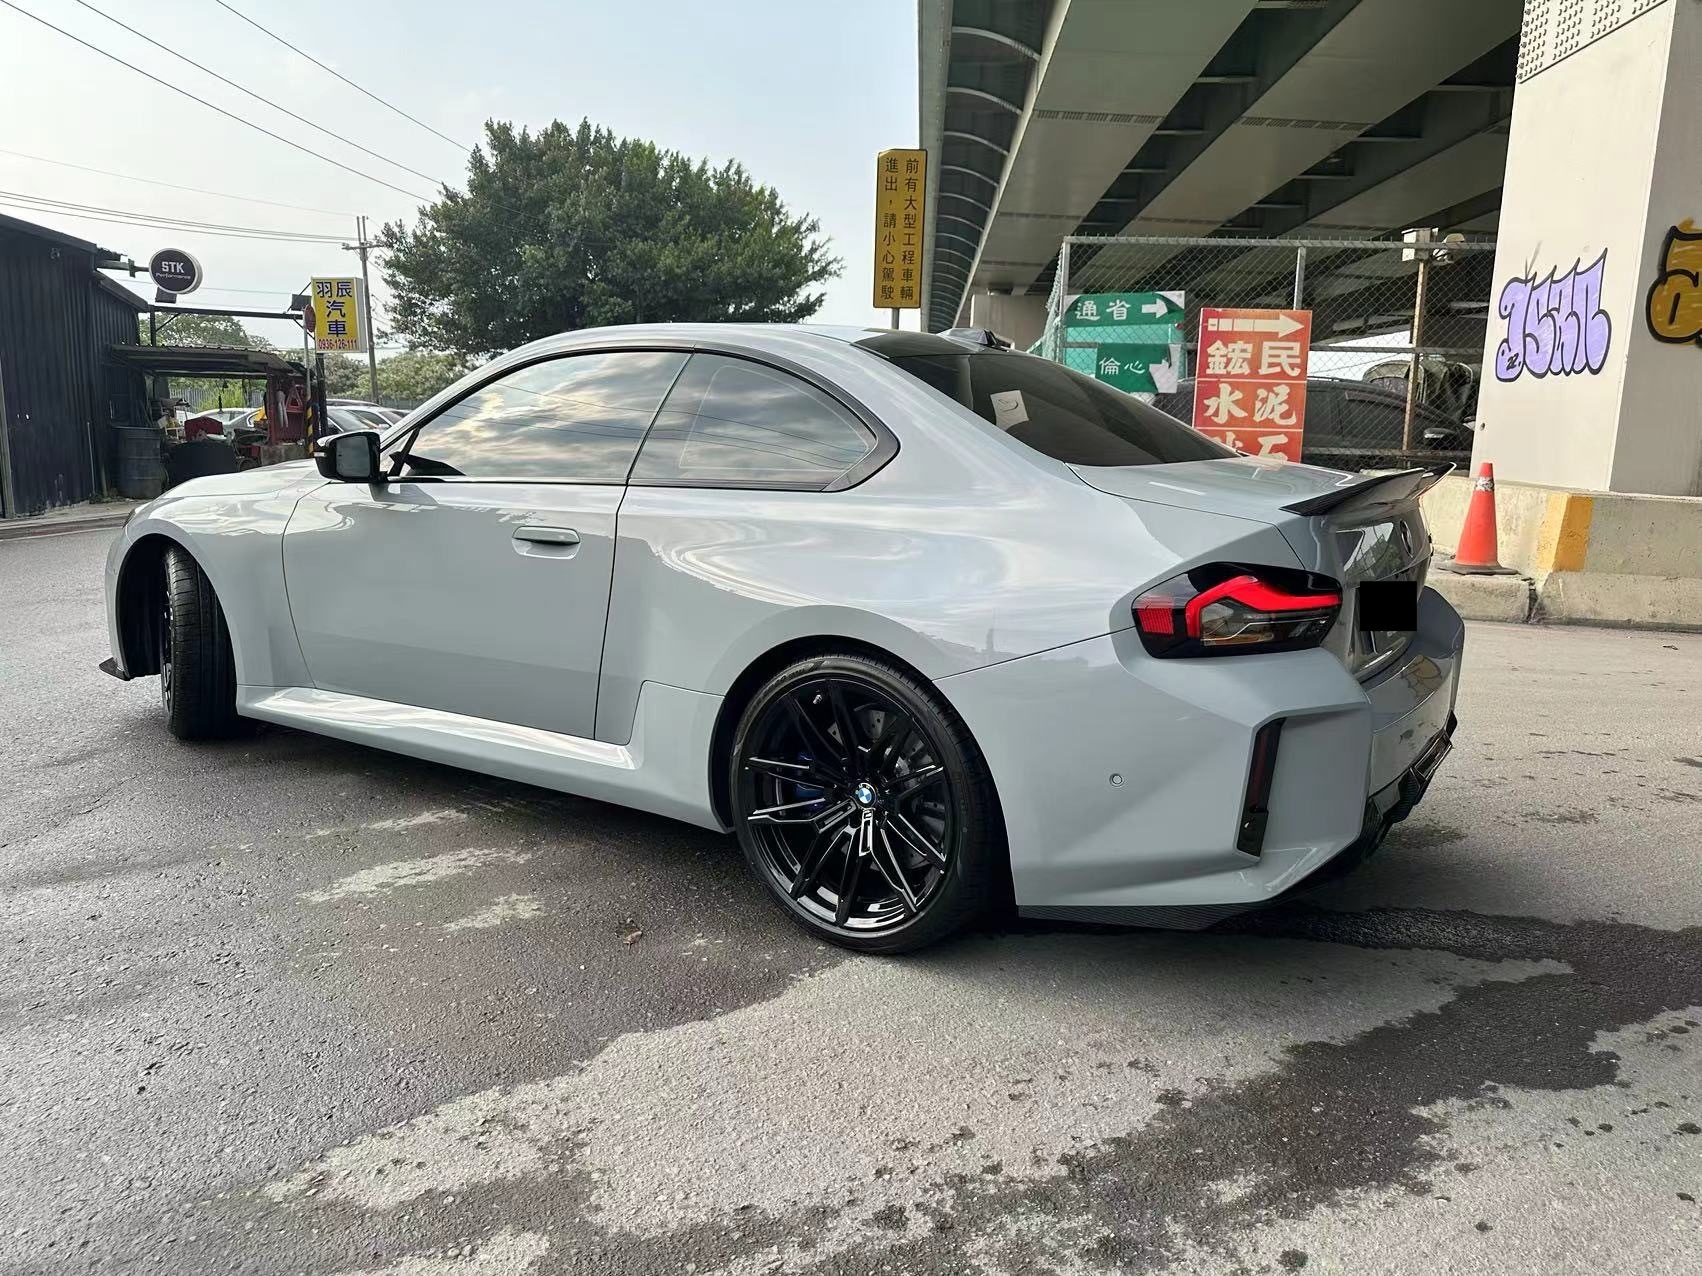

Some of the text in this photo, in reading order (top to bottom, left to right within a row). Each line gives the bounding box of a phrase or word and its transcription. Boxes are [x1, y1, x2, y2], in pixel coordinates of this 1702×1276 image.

[900, 158, 919, 301] 前有大型工程車輛
[161, 261, 185, 273] STK
[315, 281, 353, 298] 羽辰
[326, 300, 347, 338] 汽車
[1202, 382, 1297, 425] 水泥
